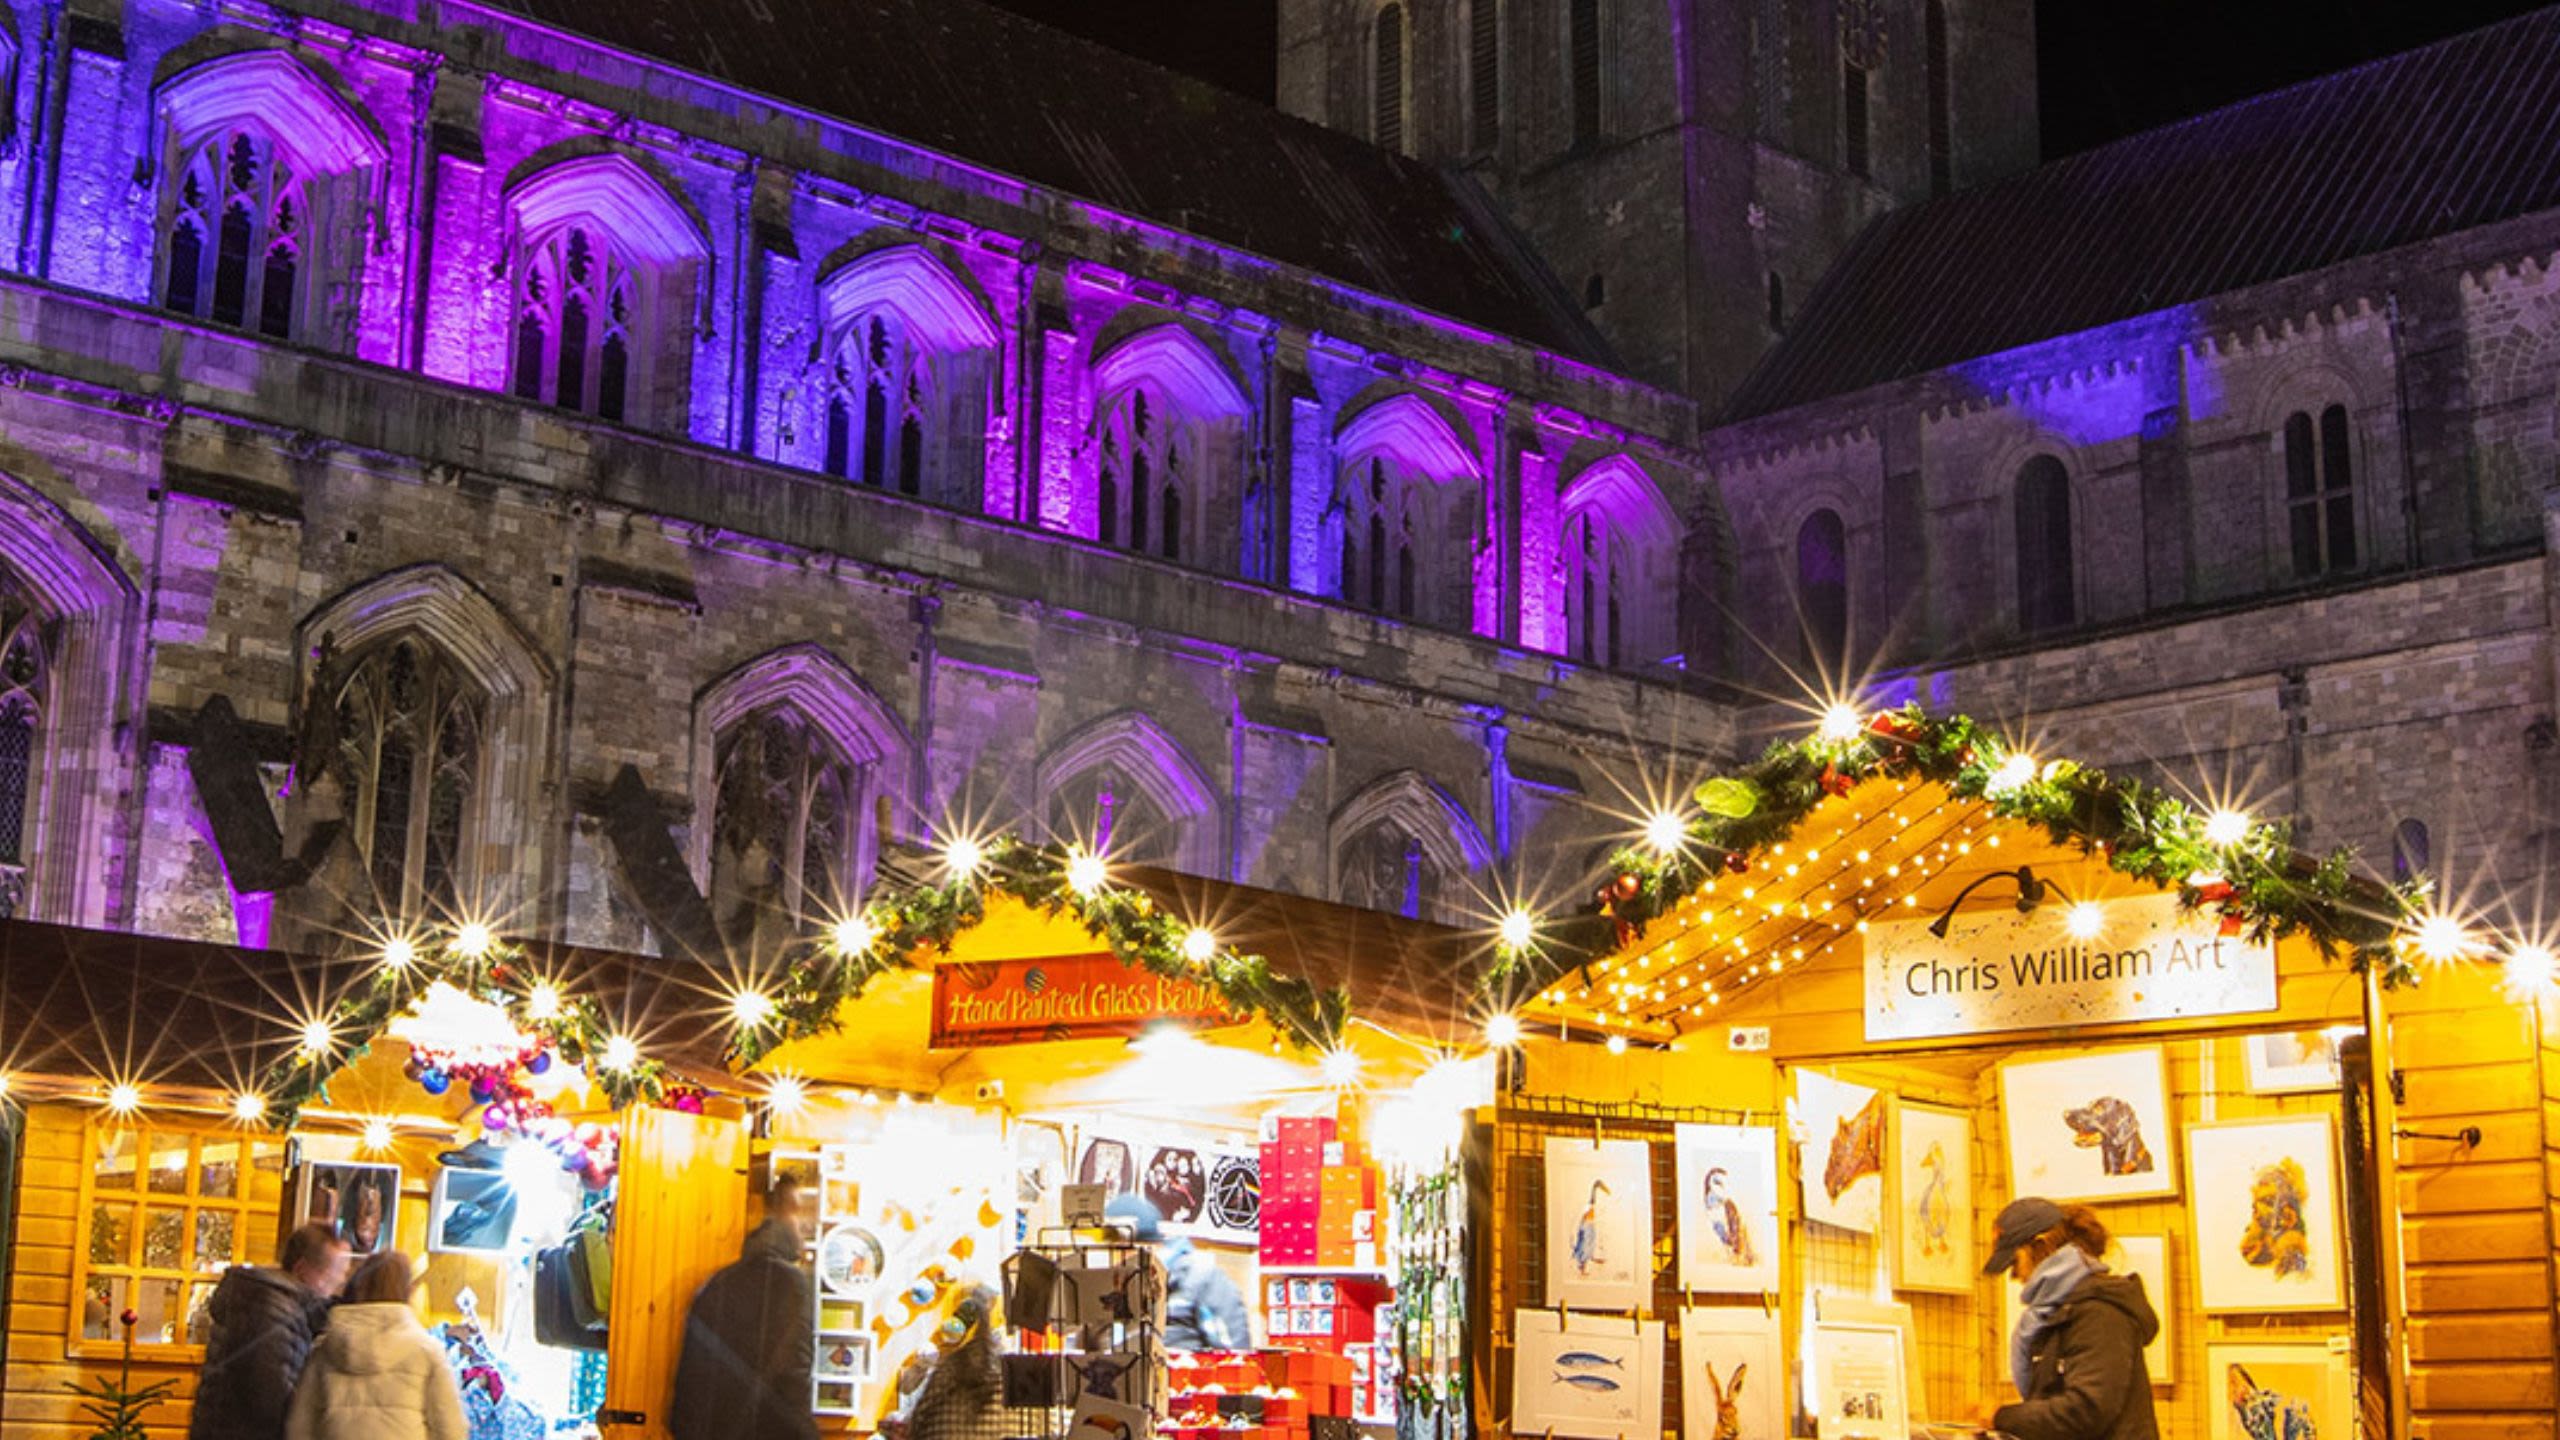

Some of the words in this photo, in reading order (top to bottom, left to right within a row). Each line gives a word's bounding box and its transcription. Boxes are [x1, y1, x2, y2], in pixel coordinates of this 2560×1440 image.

[1906, 959, 1999, 997] Chris
[2010, 946, 2152, 987] William
[2166, 938, 2226, 975] Art
[950, 988, 1011, 1025] Hand
[1011, 983, 1087, 1021] Painted
[1090, 983, 1151, 1018] Glass
